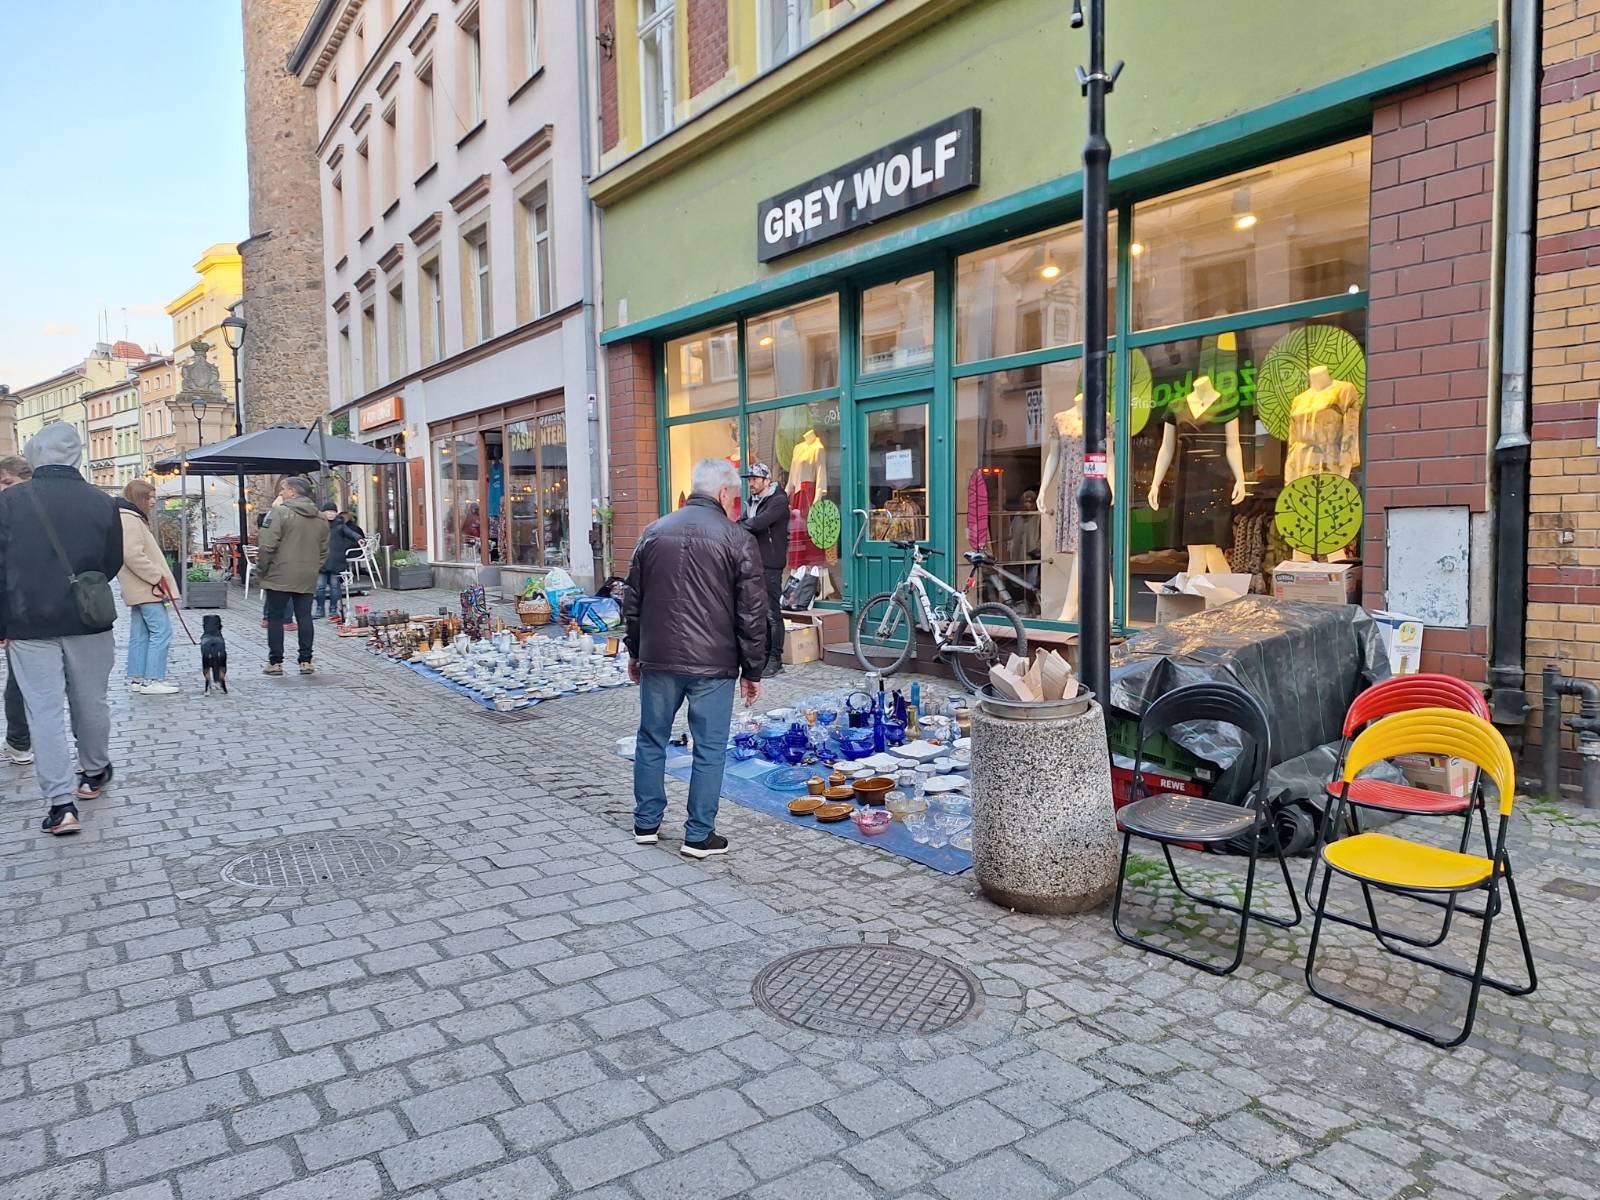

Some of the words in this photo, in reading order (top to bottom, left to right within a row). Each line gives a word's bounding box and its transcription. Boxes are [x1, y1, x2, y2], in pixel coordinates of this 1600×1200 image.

[764, 179, 844, 244] GREY
[853, 130, 958, 210] WOLF
[1160, 778, 1185, 792] REWE
